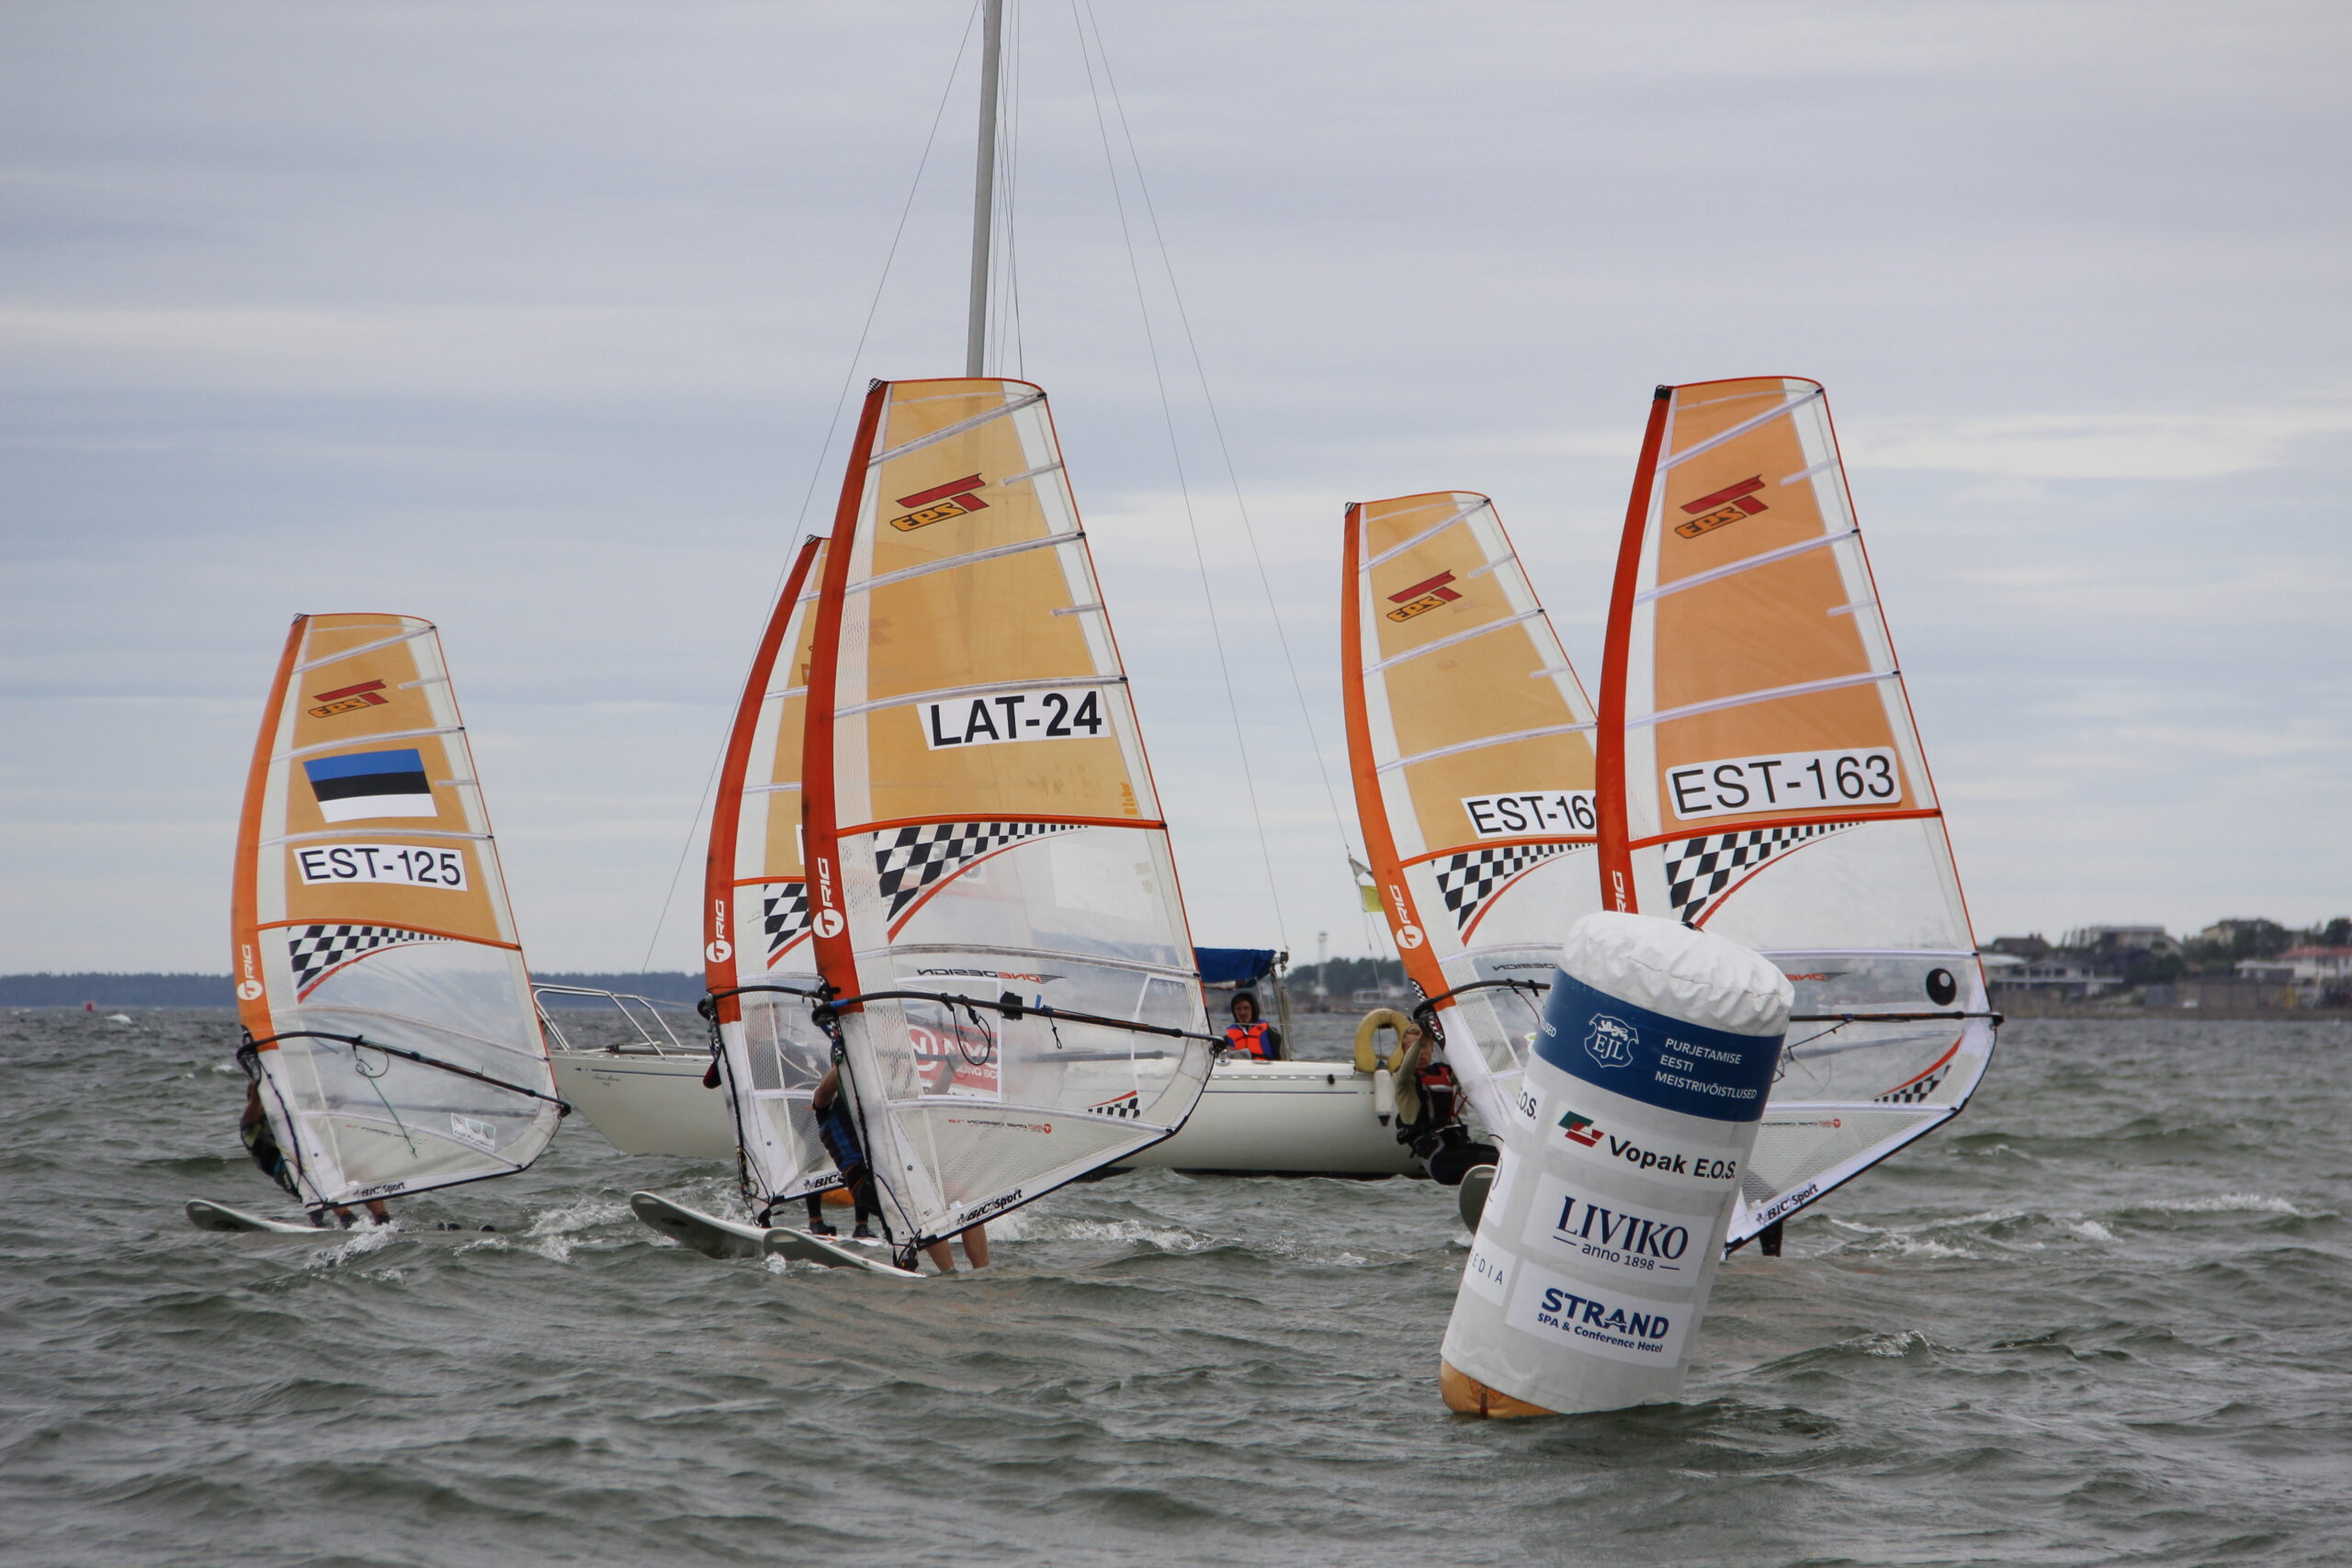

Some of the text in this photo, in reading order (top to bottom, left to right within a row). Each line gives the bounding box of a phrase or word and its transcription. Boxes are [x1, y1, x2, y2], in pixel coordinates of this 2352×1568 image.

[930, 691, 1102, 747] LAT-24
[1672, 754, 1895, 812] EST-163
[1467, 795, 1597, 836] EST-16
[300, 847, 460, 886] EST-125
[818, 857, 832, 908] RIG
[715, 899, 725, 939] RIG
[1389, 885, 1411, 924] RIG
[1593, 1033, 1624, 1060] EJL
[1659, 1054, 1694, 1073] EESTI
[1665, 1037, 1743, 1065] PURJETAMISE
[1655, 1071, 1758, 1100] MEISTRIVÕISTLUSED
[1609, 1134, 1736, 1179] Vopak E.O.S.
[966, 1188, 1023, 1222] BIC Sport
[1767, 1183, 1819, 1221] BIC Sport
[1555, 1195, 1689, 1260] LIVIKO
[1581, 1243, 1655, 1270] anno 1898
[1541, 1287, 1670, 1339] STRAND
[1537, 1313, 1663, 1353] SPA & Conference Hotel
